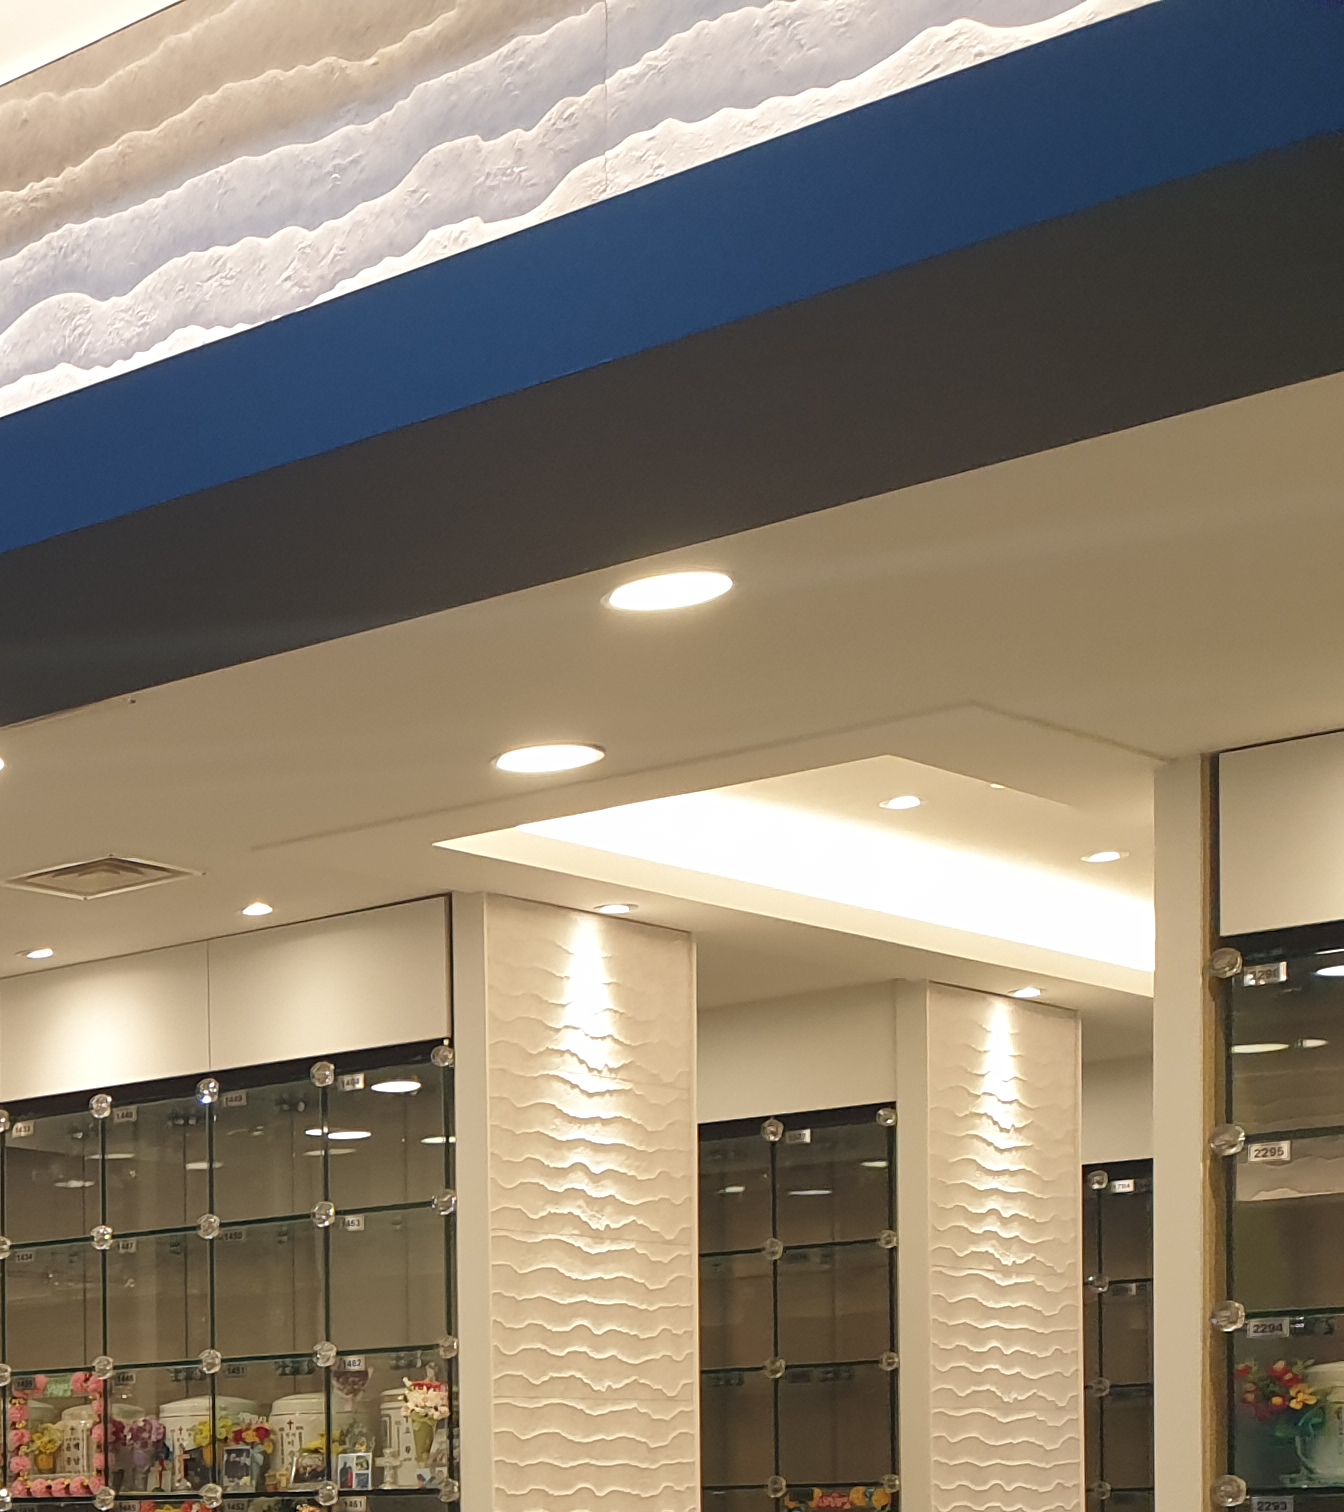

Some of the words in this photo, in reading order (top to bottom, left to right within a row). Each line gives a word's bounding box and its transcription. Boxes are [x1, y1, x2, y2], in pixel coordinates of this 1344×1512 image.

[1254, 1146, 1284, 1158] 2295
[1253, 1322, 1283, 1334] 2294
[344, 1358, 361, 1367] 1462
[1257, 1502, 1287, 1512] 2293
